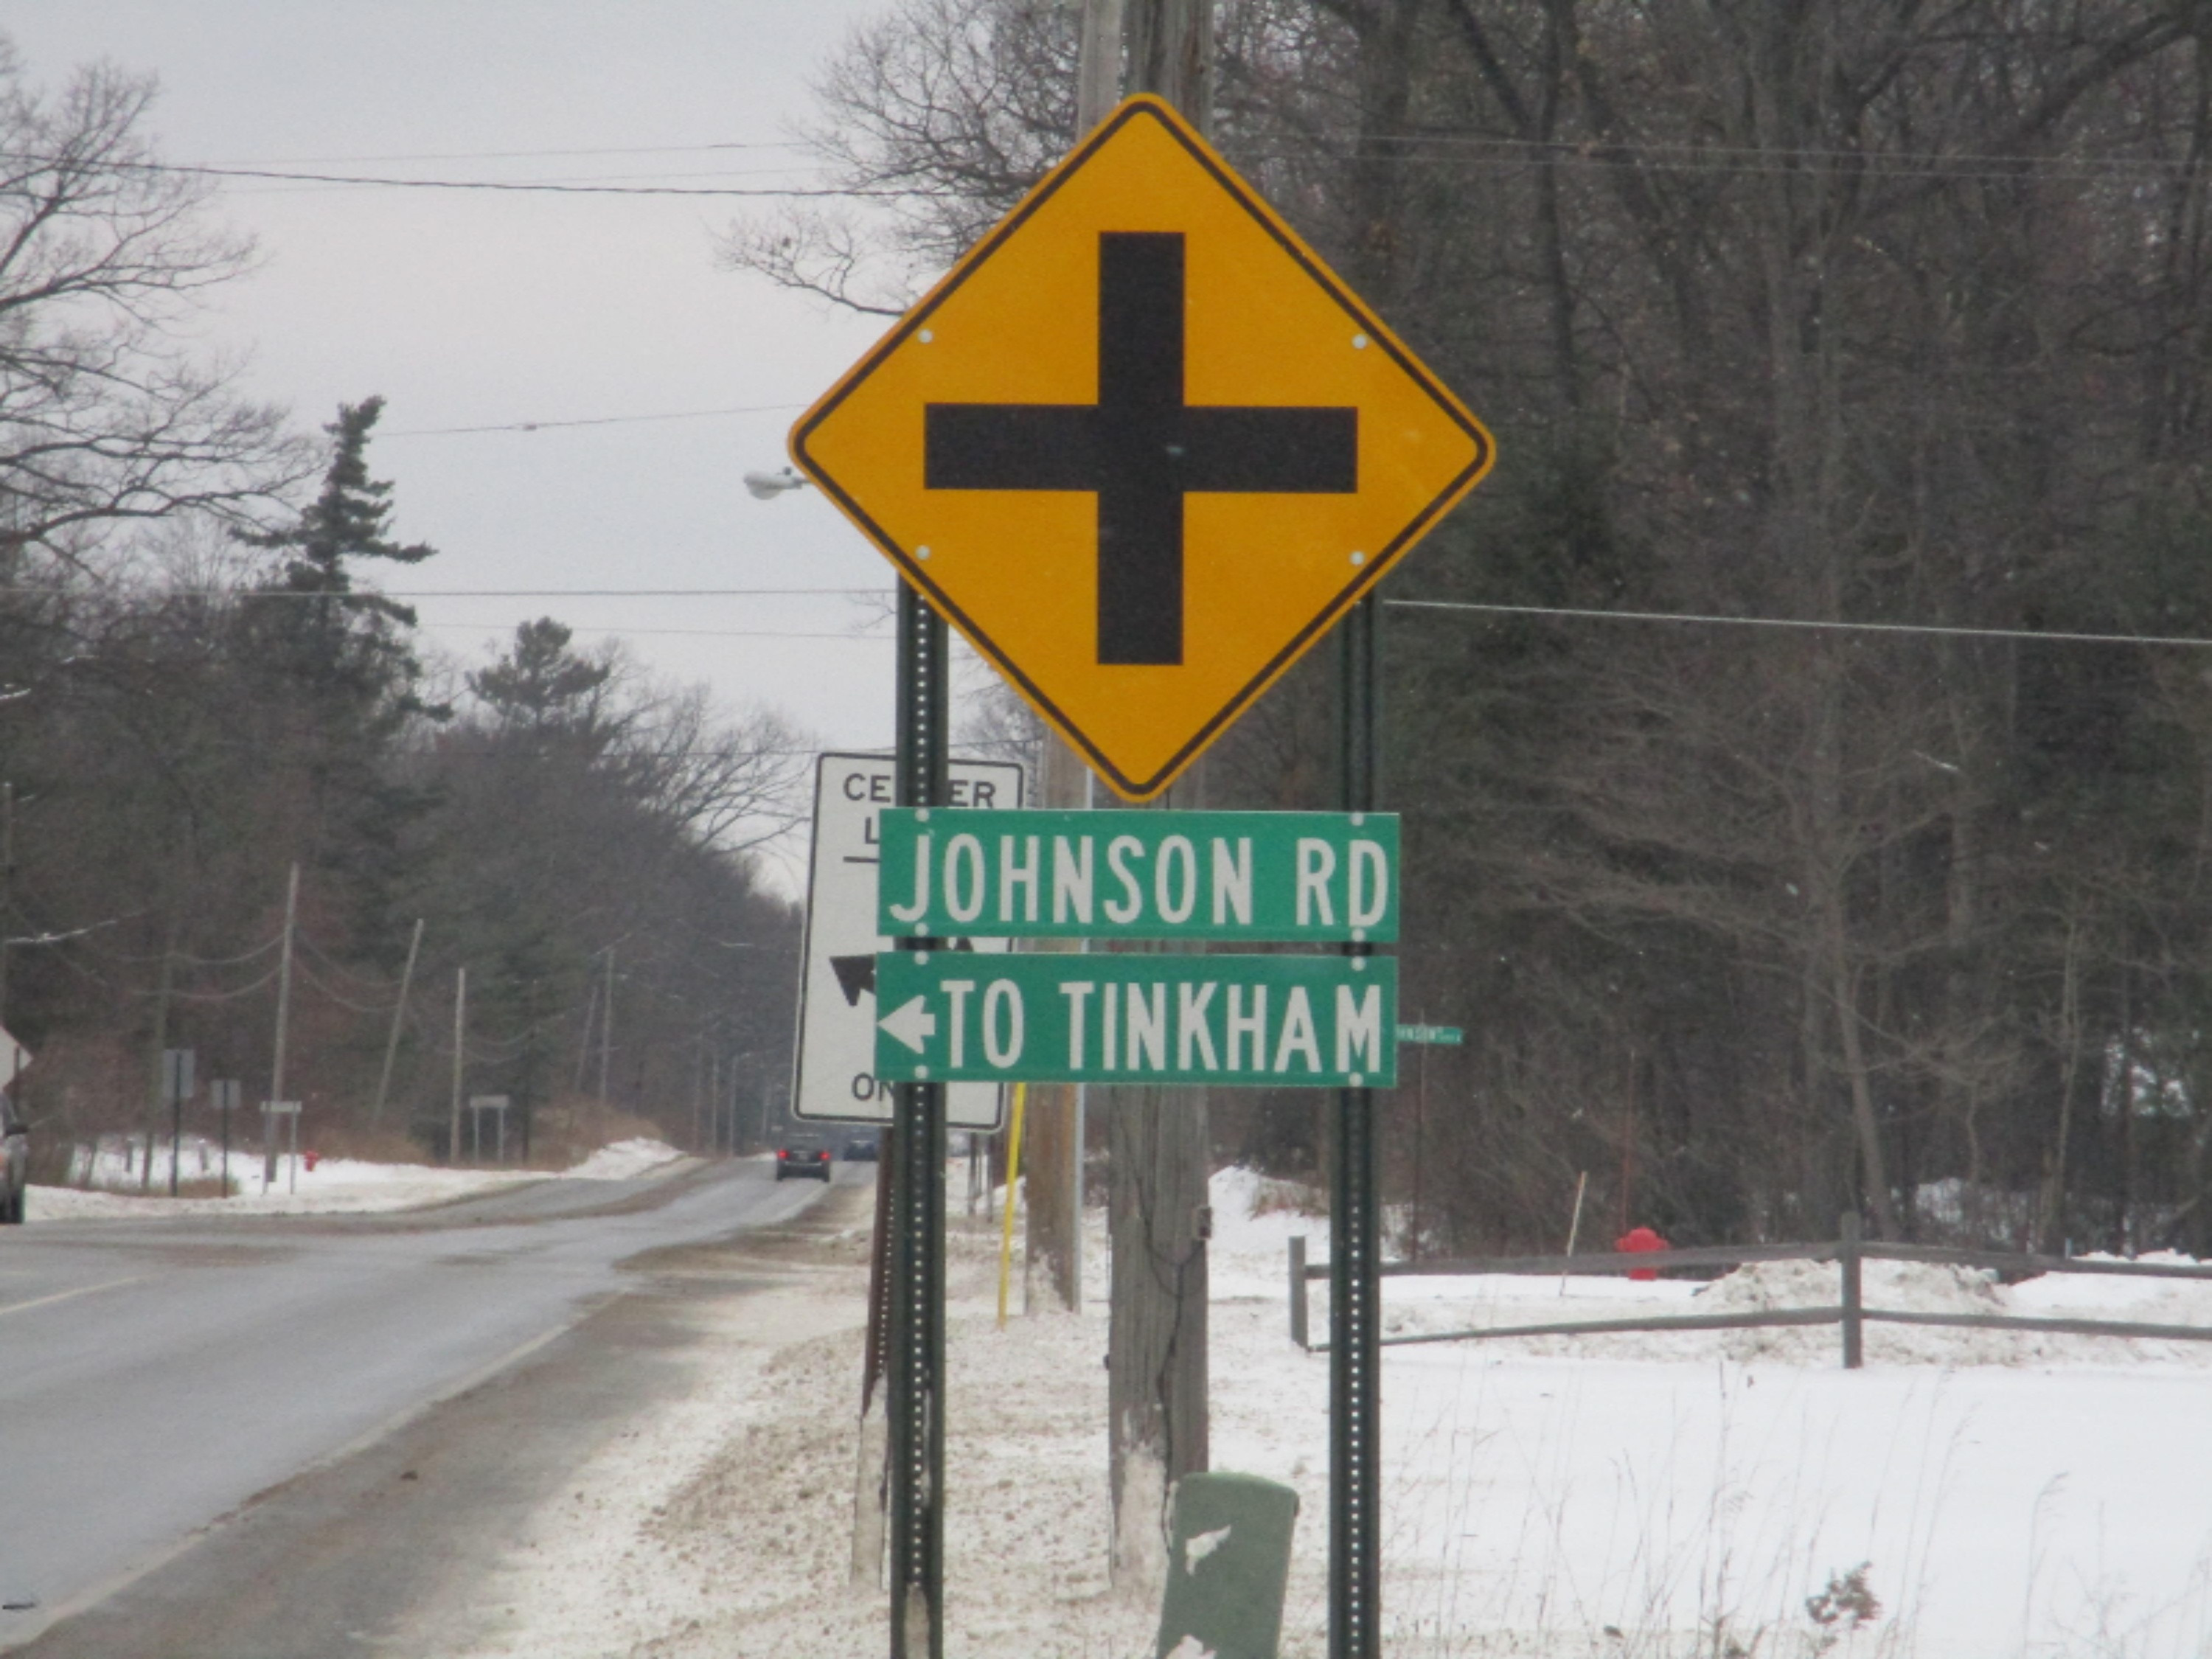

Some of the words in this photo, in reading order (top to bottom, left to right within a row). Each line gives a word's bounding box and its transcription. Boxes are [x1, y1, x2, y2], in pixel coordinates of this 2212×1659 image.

[843, 773, 996, 809] CEER
[889, 832, 1252, 926] JOHNSON
[1295, 837, 1389, 928] RD
[940, 978, 1025, 1069] TO
[1059, 981, 1381, 1074] TINKHAM
